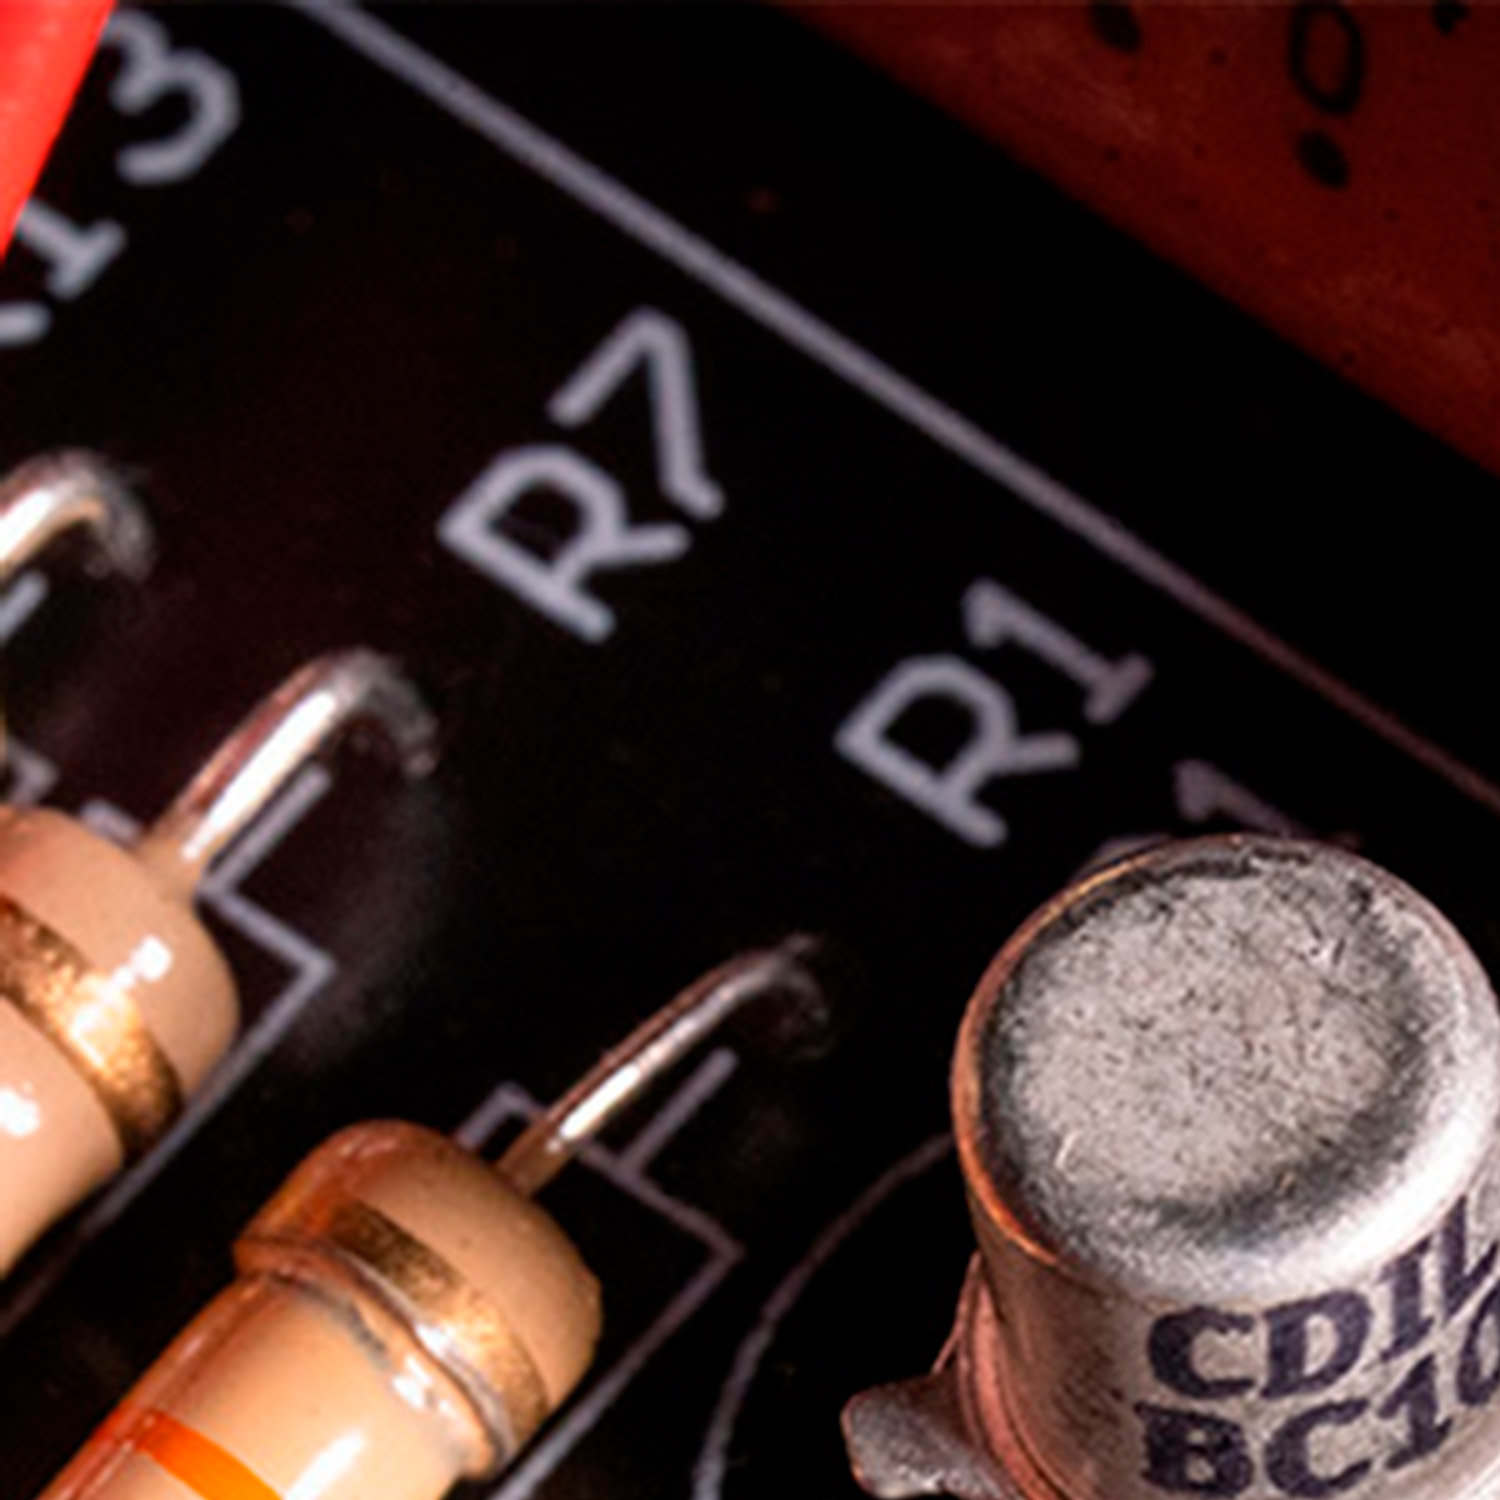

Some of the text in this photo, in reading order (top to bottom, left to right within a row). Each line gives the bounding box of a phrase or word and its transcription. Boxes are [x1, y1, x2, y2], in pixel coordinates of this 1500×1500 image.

[0, 8, 242, 345] 13
[437, 305, 723, 643] R7
[835, 578, 1153, 847] R1
[1147, 1194, 1500, 1400] CDIL
